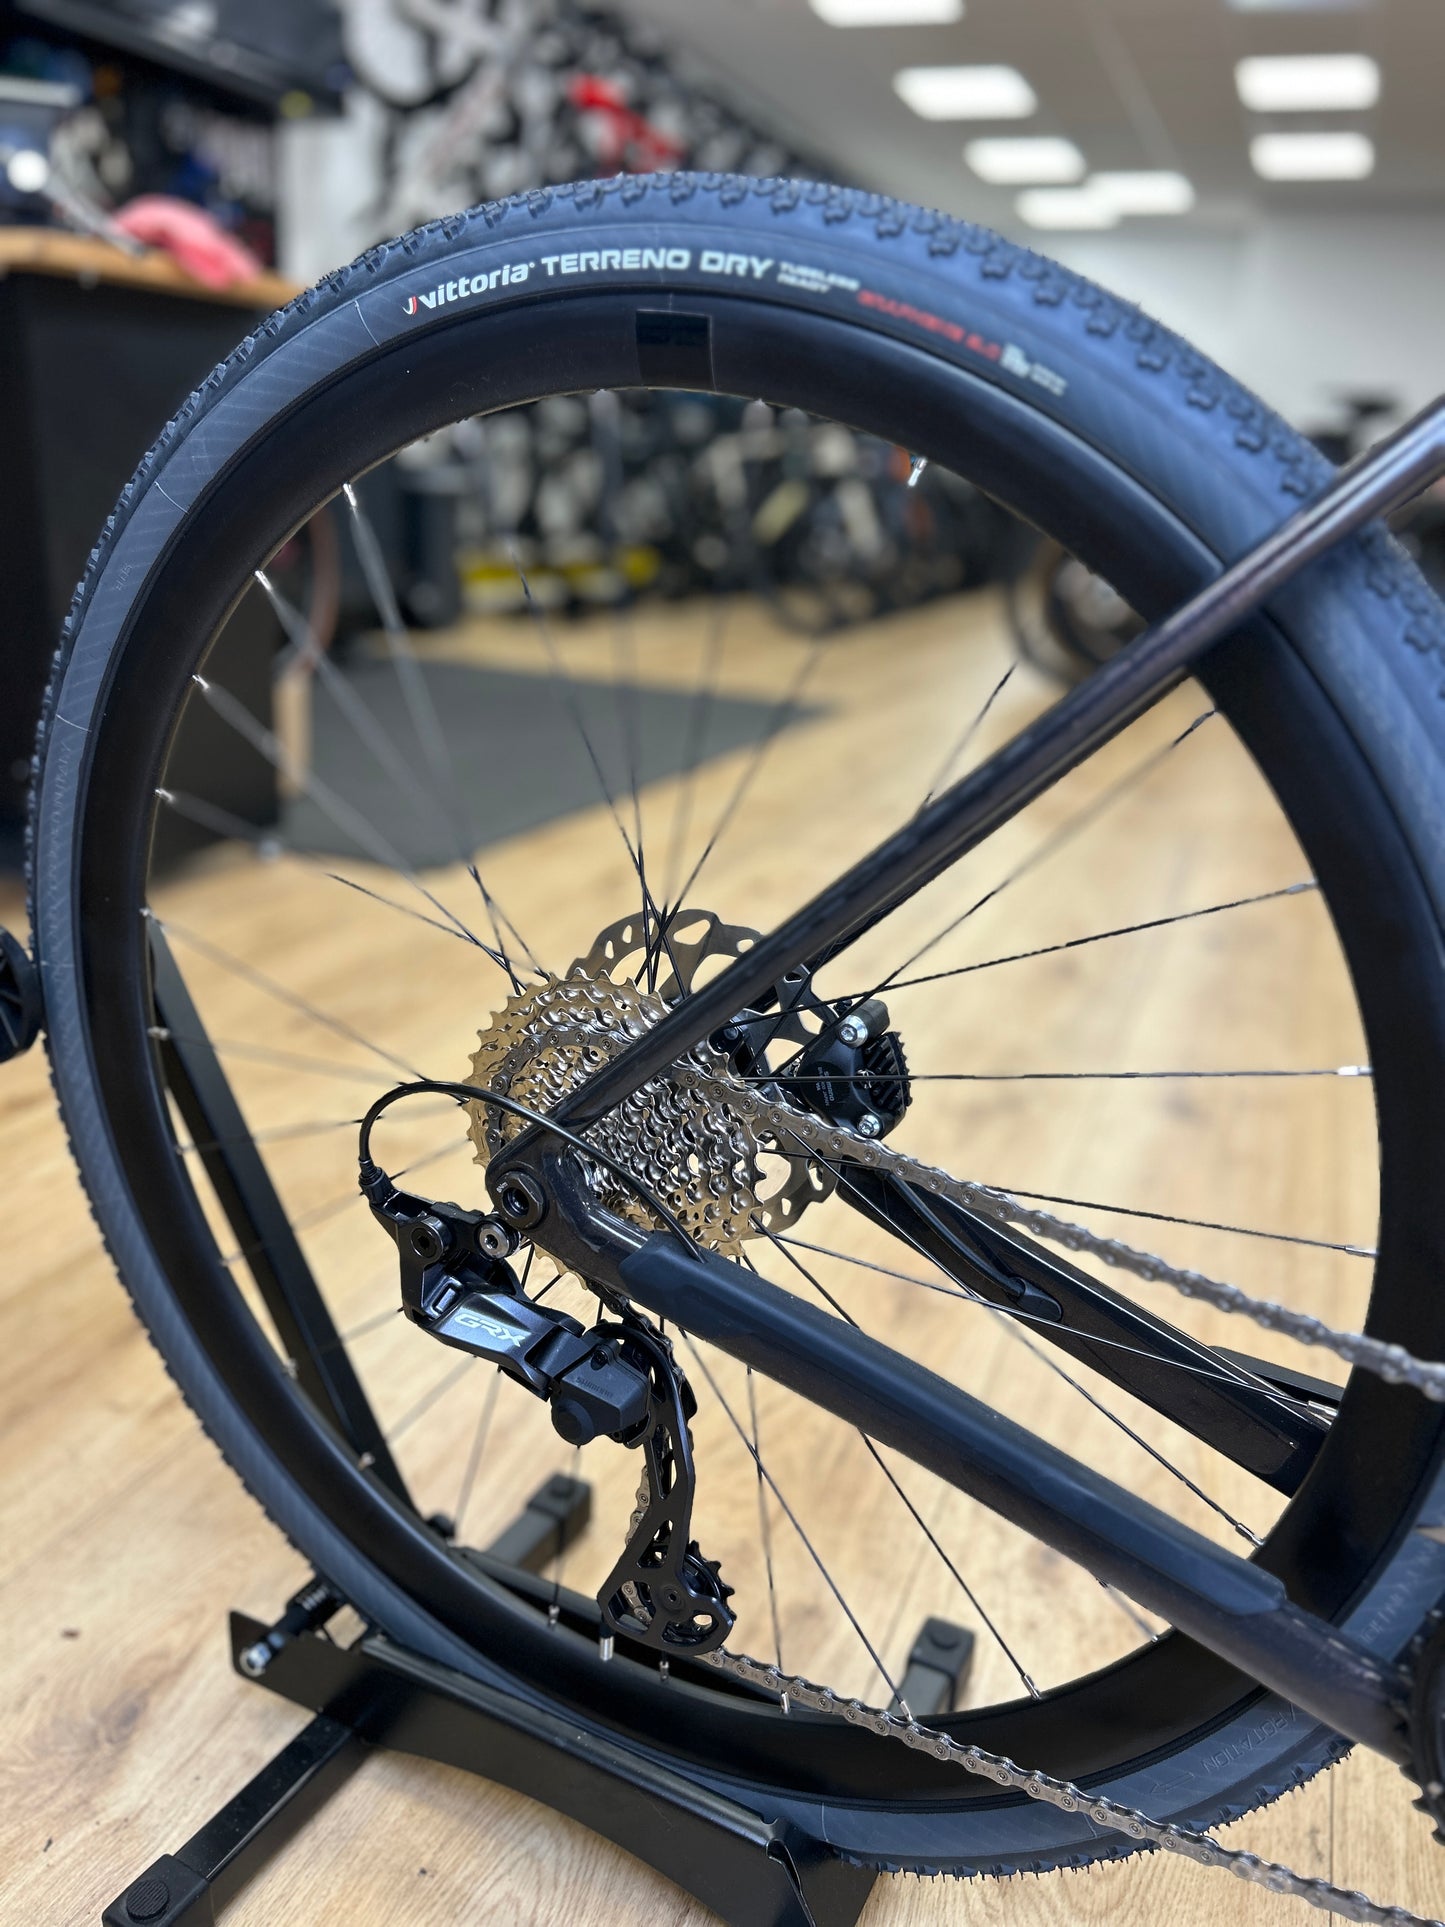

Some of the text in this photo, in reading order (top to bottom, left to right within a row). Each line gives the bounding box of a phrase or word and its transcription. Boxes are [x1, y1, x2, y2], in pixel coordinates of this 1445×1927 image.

[418, 248, 774, 309] vittoria TERRENO DRY
[455, 1313, 526, 1347] GRX
